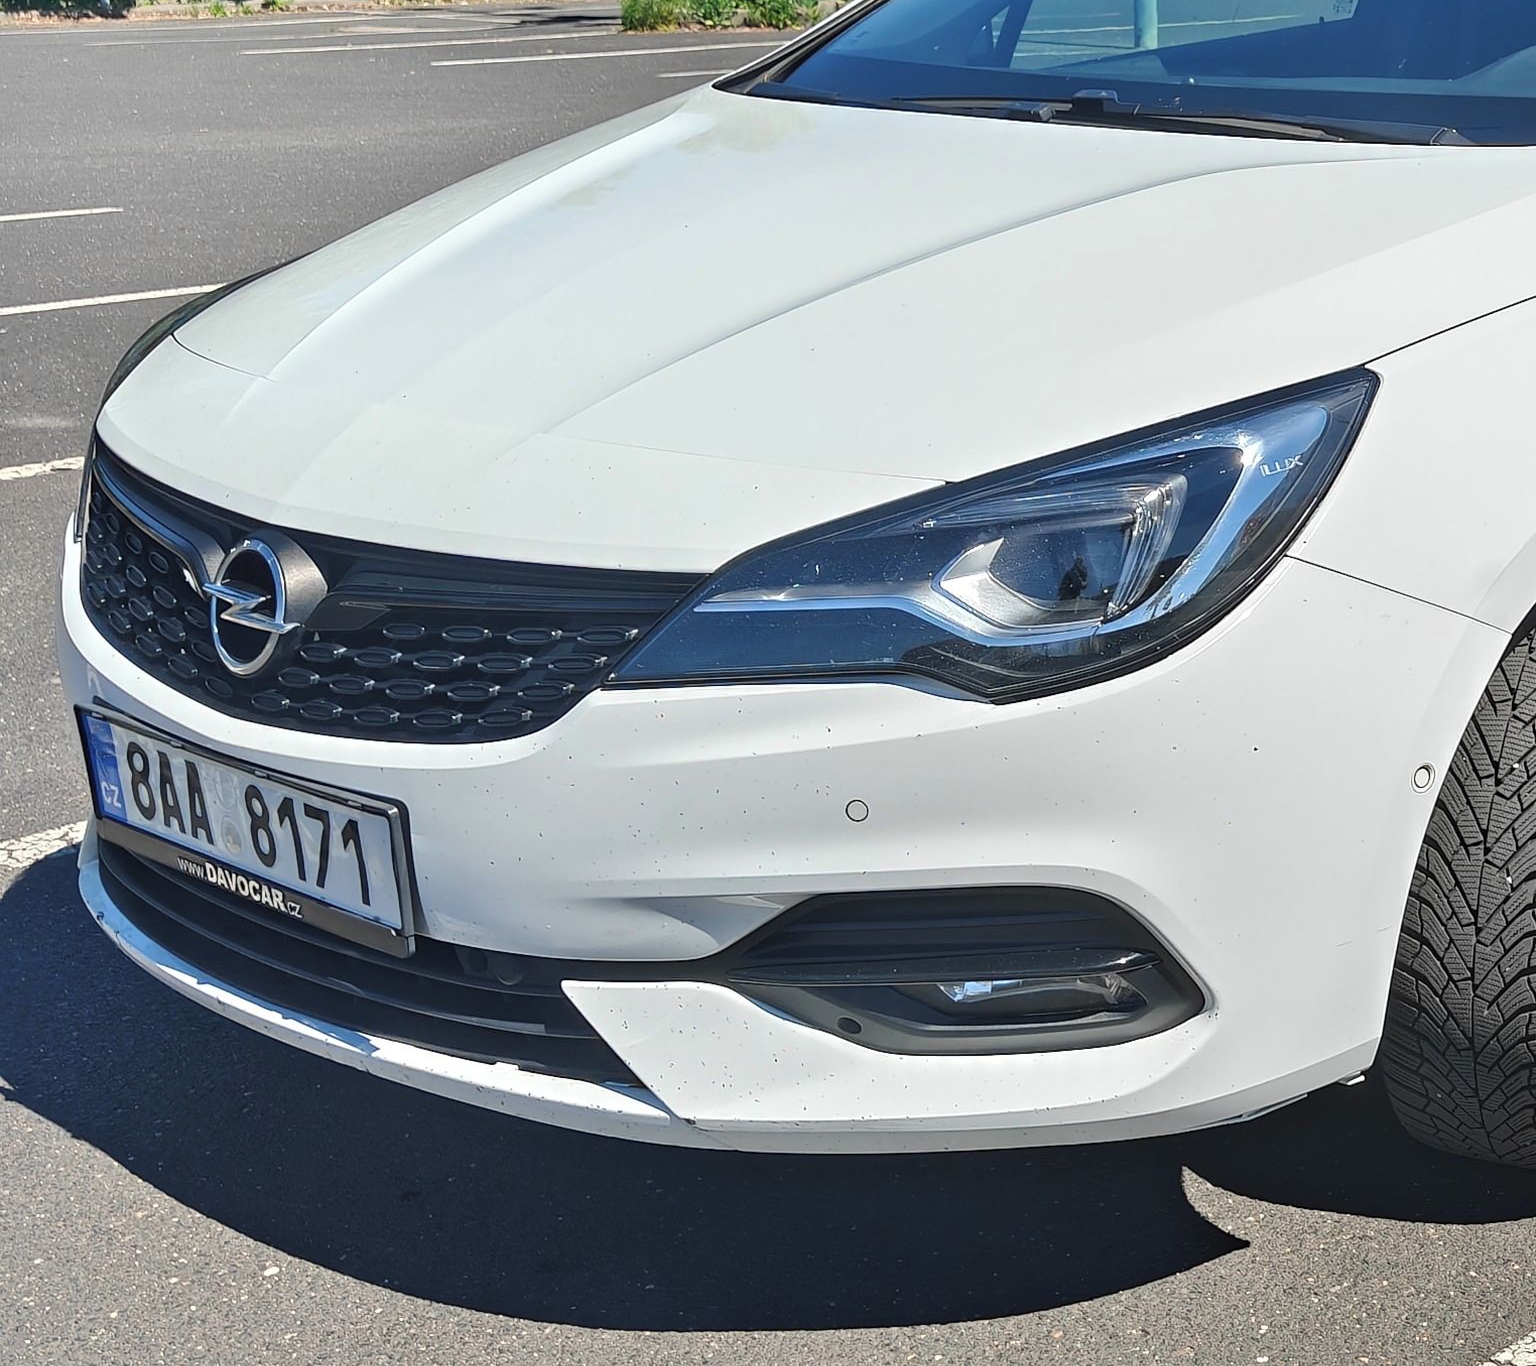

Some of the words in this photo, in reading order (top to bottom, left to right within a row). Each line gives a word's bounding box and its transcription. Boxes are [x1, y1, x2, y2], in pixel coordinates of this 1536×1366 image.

[101, 781, 122, 808] CZ
[127, 741, 214, 846] 8AA
[245, 784, 371, 907] 8171
